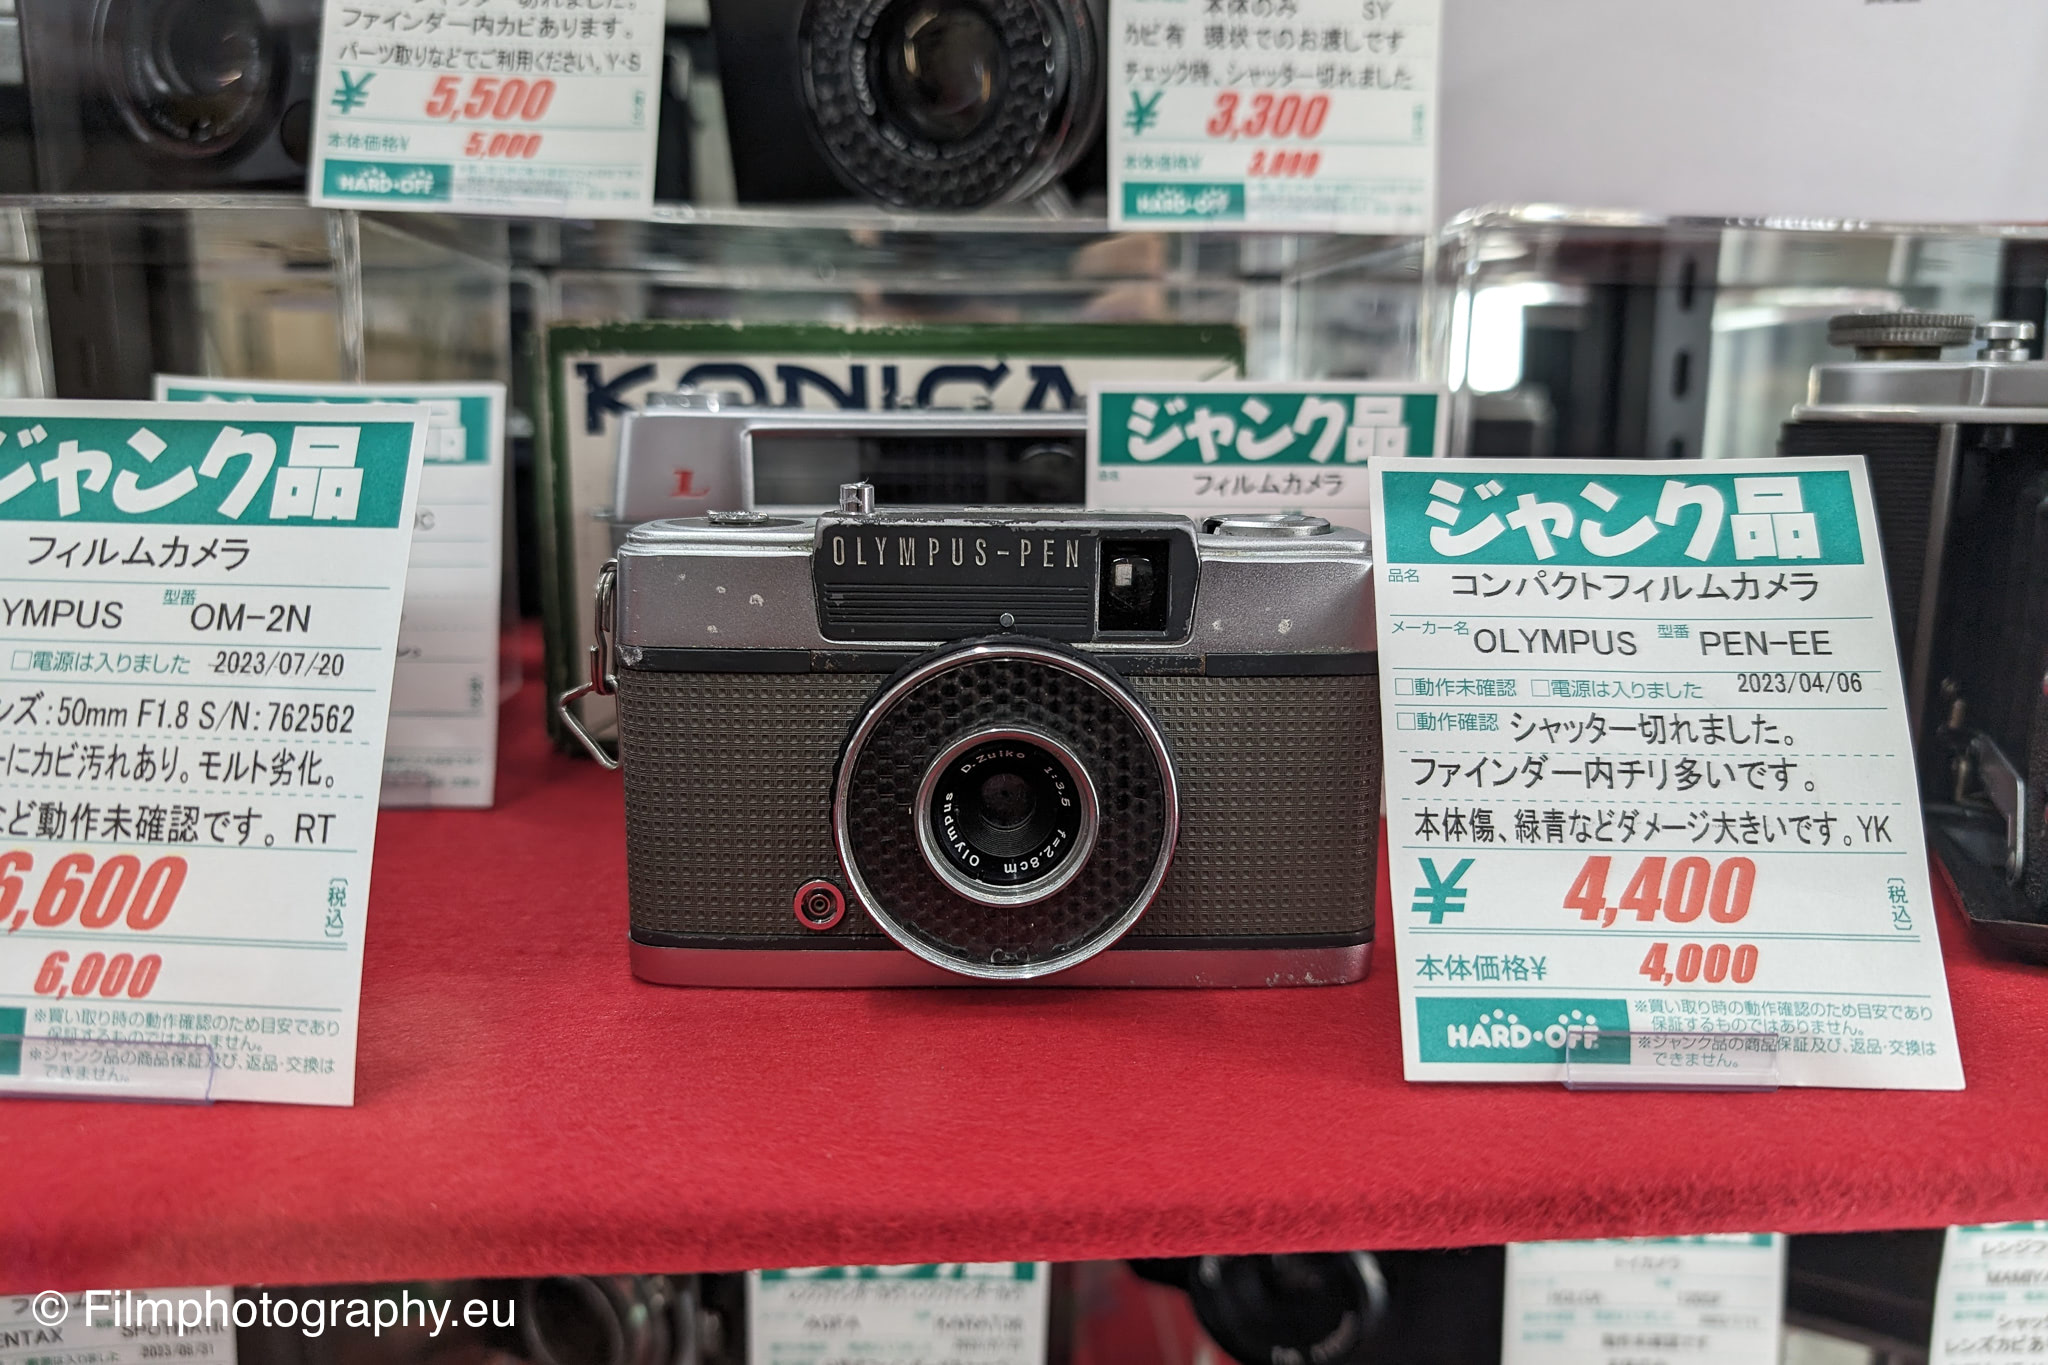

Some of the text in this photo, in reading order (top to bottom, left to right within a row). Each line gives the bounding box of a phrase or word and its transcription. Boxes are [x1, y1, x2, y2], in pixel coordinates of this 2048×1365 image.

[424, 76, 557, 122] 5,500
[1206, 92, 1330, 141] 3,300
[464, 132, 543, 160] 5,000
[1126, 396, 1410, 464] ジャンク品
[1193, 473, 1344, 497] フィルムカメラ
[1424, 476, 1822, 561] ジャンク品
[28, 536, 251, 571] フィルムカメラ
[832, 535, 1079, 569] OLYMPUS-PEN
[1388, 569, 1819, 603] 品名 コンパクトフィルムカメラ
[162, 588, 197, 607] 型番
[190, 602, 311, 633] OM-2N
[1391, 621, 1834, 657] メーカー名 OLYMPUS 型番 PEN-EE
[1736, 672, 1863, 694] 2023/04/06
[137, 698, 190, 728] F1.8
[1508, 711, 1795, 748] シャッター切れました。
[1411, 755, 1817, 793] ファインダー内チリ多いです。
[943, 792, 980, 867] Olympus
[1562, 854, 1757, 929] 4,400
[33, 950, 163, 1001] 6,000
[1638, 941, 1759, 987] 4,000
[1655, 1052, 1739, 1069] できません。
